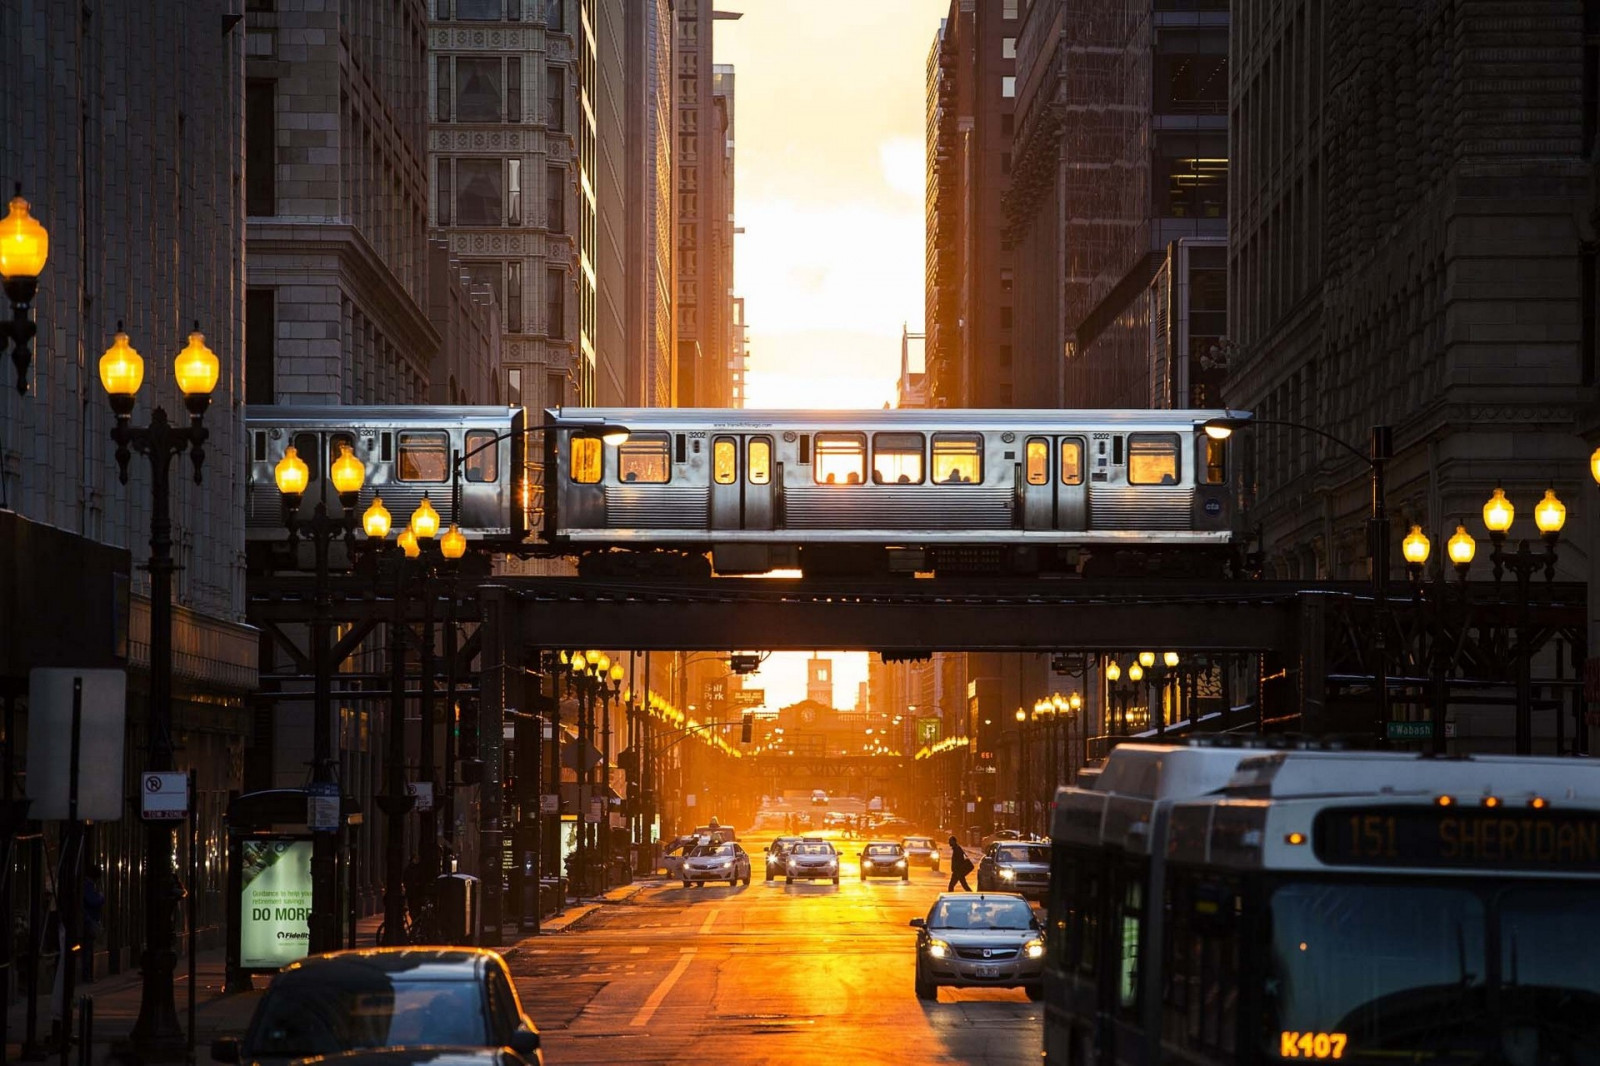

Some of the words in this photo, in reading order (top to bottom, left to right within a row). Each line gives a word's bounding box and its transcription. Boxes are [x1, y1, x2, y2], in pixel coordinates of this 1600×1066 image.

[360, 429, 377, 437] 3201
[689, 431, 706, 439] 3202
[1093, 432, 1110, 440] 3202
[1396, 724, 1432, 736] Wabash
[1349, 815, 1398, 858] 151
[1438, 817, 1598, 863] SHERIDAN
[252, 907, 271, 921] DO
[1281, 1031, 1347, 1059] K407
